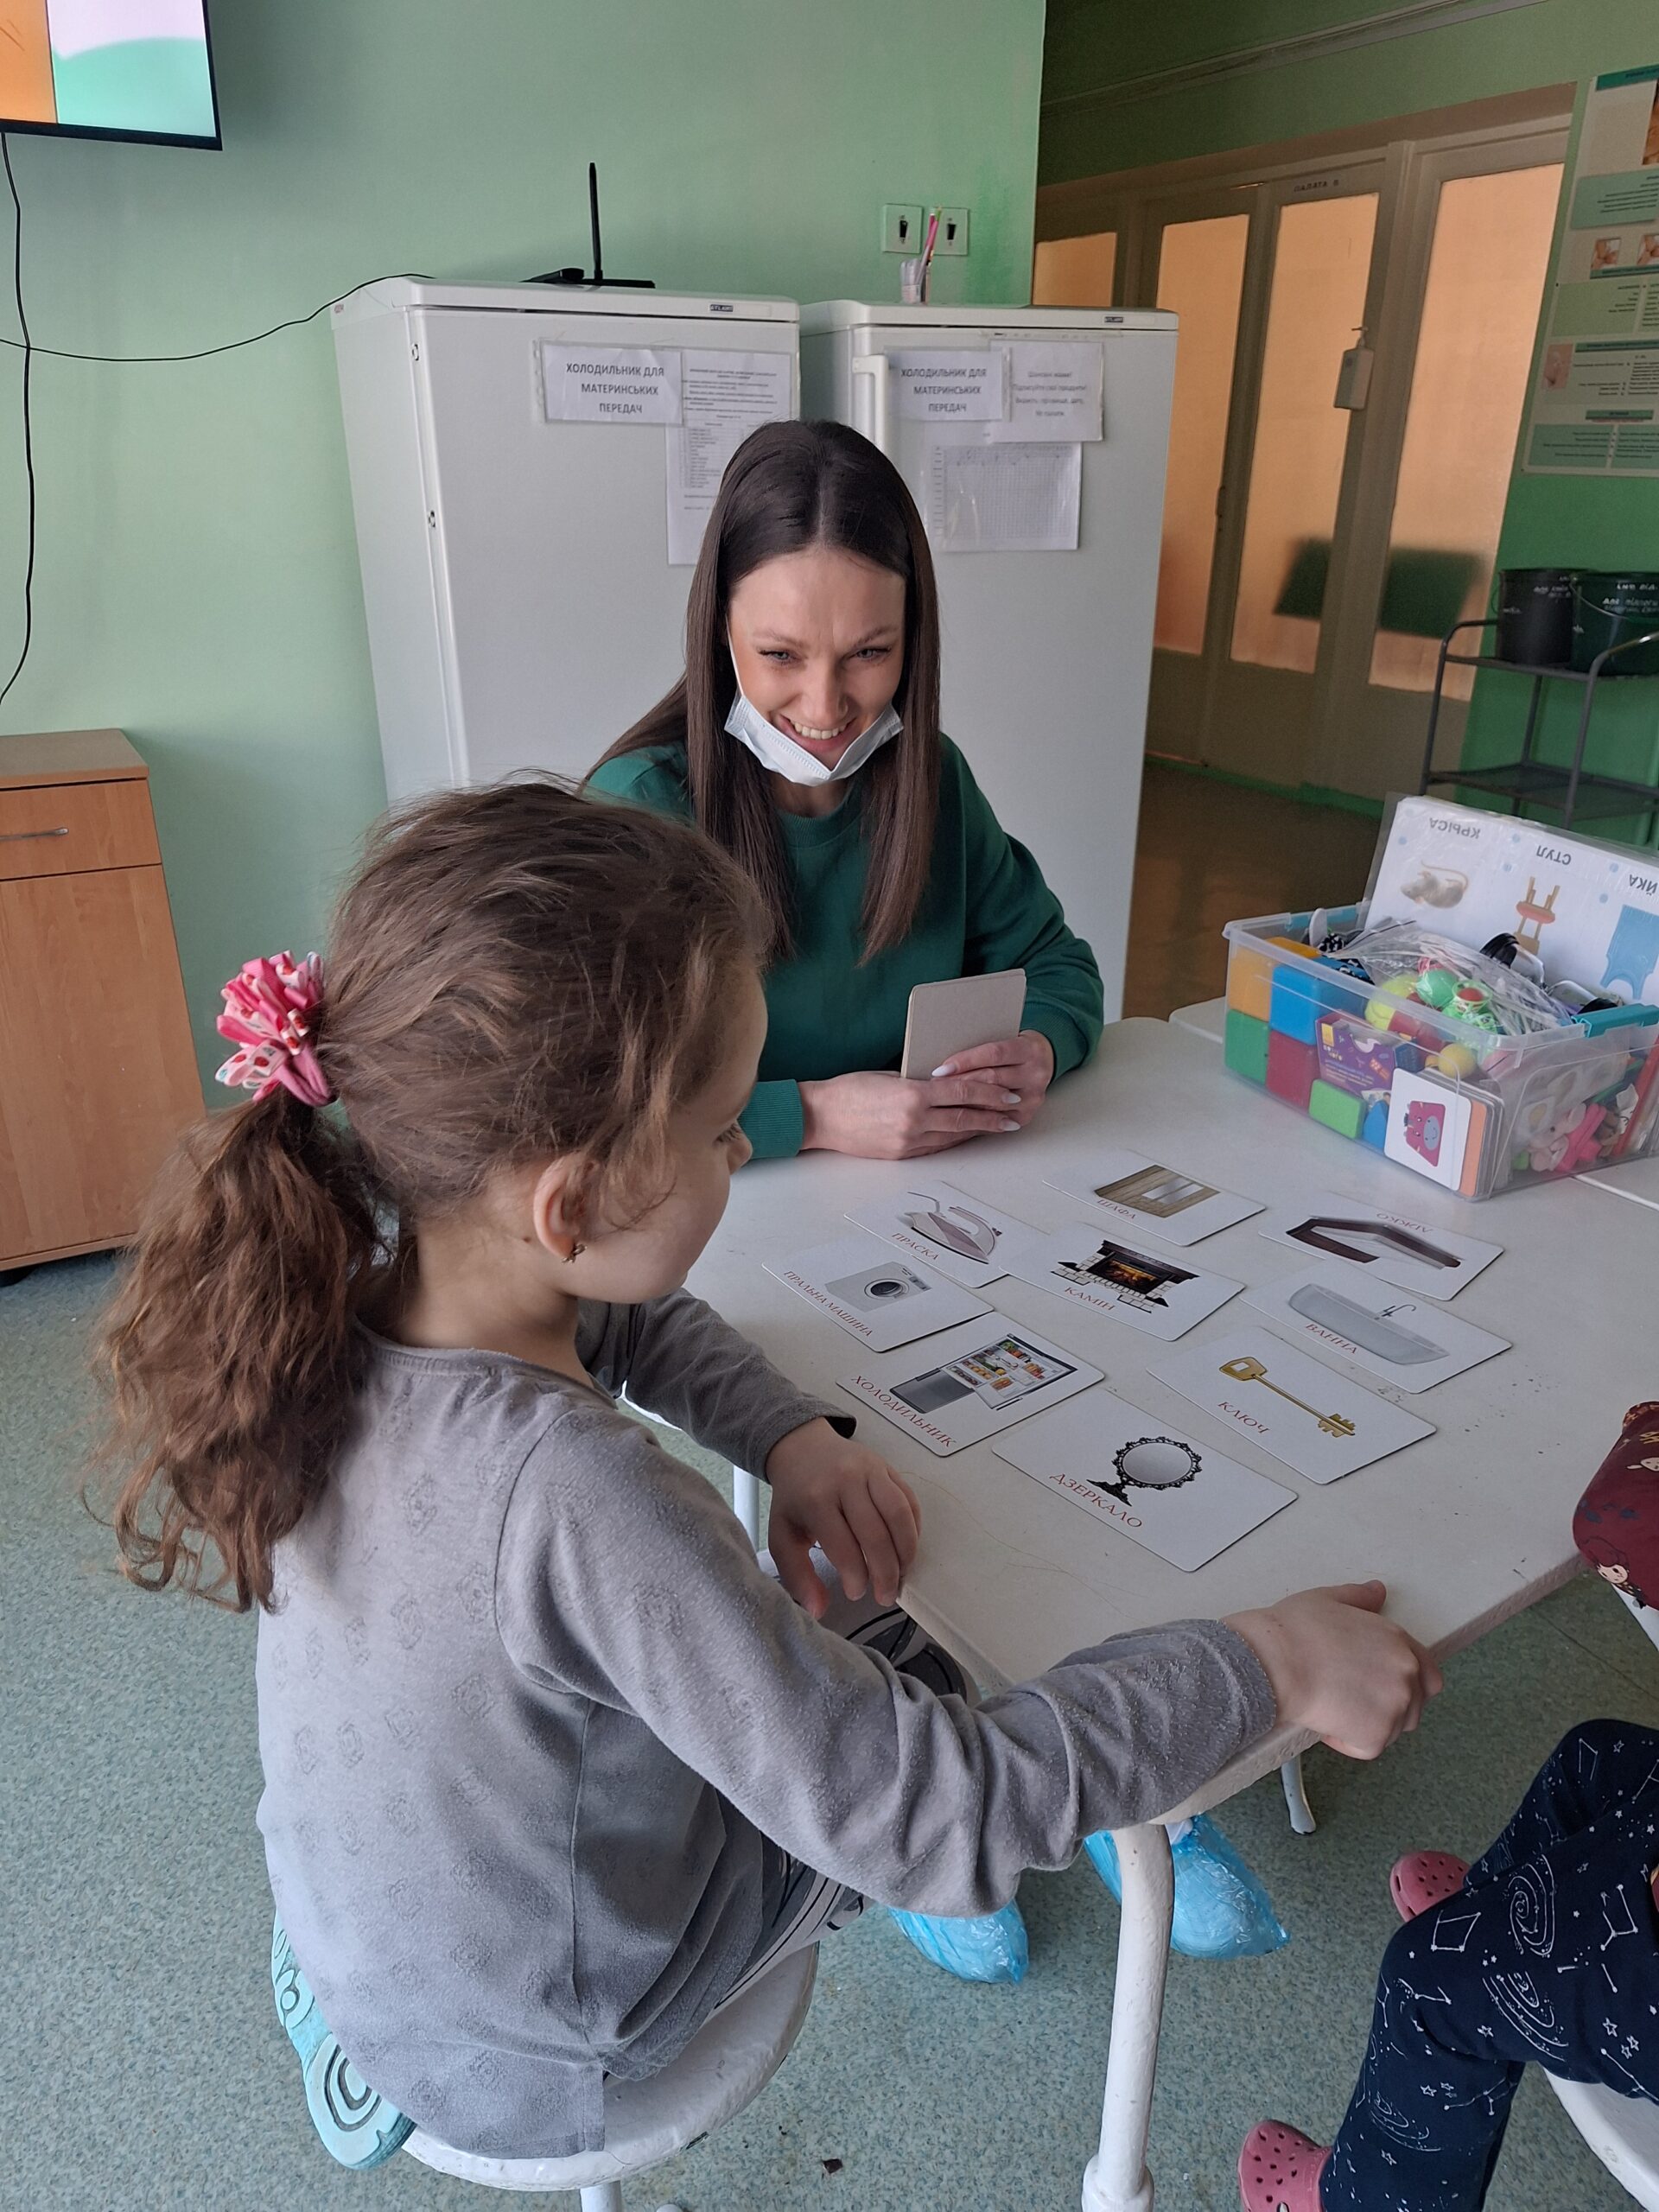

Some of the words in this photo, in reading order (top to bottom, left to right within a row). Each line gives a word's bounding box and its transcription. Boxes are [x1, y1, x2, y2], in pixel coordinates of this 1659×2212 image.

[566, 363, 641, 377] ХОЛОДИЛЬНИК
[644, 366, 664, 378] ДЛЯ
[900, 368, 967, 378] ХОЛОДИЛЬНИК
[969, 368, 987, 378] ДЛЯ
[581, 384, 658, 396] МАТЕРИНСЬКИХ
[913, 385, 982, 395] МАТЕРИНСЬКИХ
[599, 403, 643, 415] ПЕРЕДАЧ
[928, 403, 967, 413] ПЕРЕДАЧ
[1428, 817, 1481, 840] КРЫСА
[1535, 844, 1573, 866] СТУЛ
[1628, 874, 1658, 896] ЙКА
[1096, 1199, 1136, 1219] ШАФА
[891, 1232, 939, 1260] ПРАСКА
[784, 1270, 827, 1304] ПРАЛЬНА
[824, 1301, 873, 1337] МАШИНА
[1065, 1287, 1116, 1311] КАМІН
[1305, 1322, 1357, 1355] ВАННА
[850, 1375, 957, 1448] ХОЛОДИЛЬНИК
[1217, 1401, 1270, 1434] КЛЮЧ
[1049, 1472, 1142, 1528] ДЗЕРКАЛО
